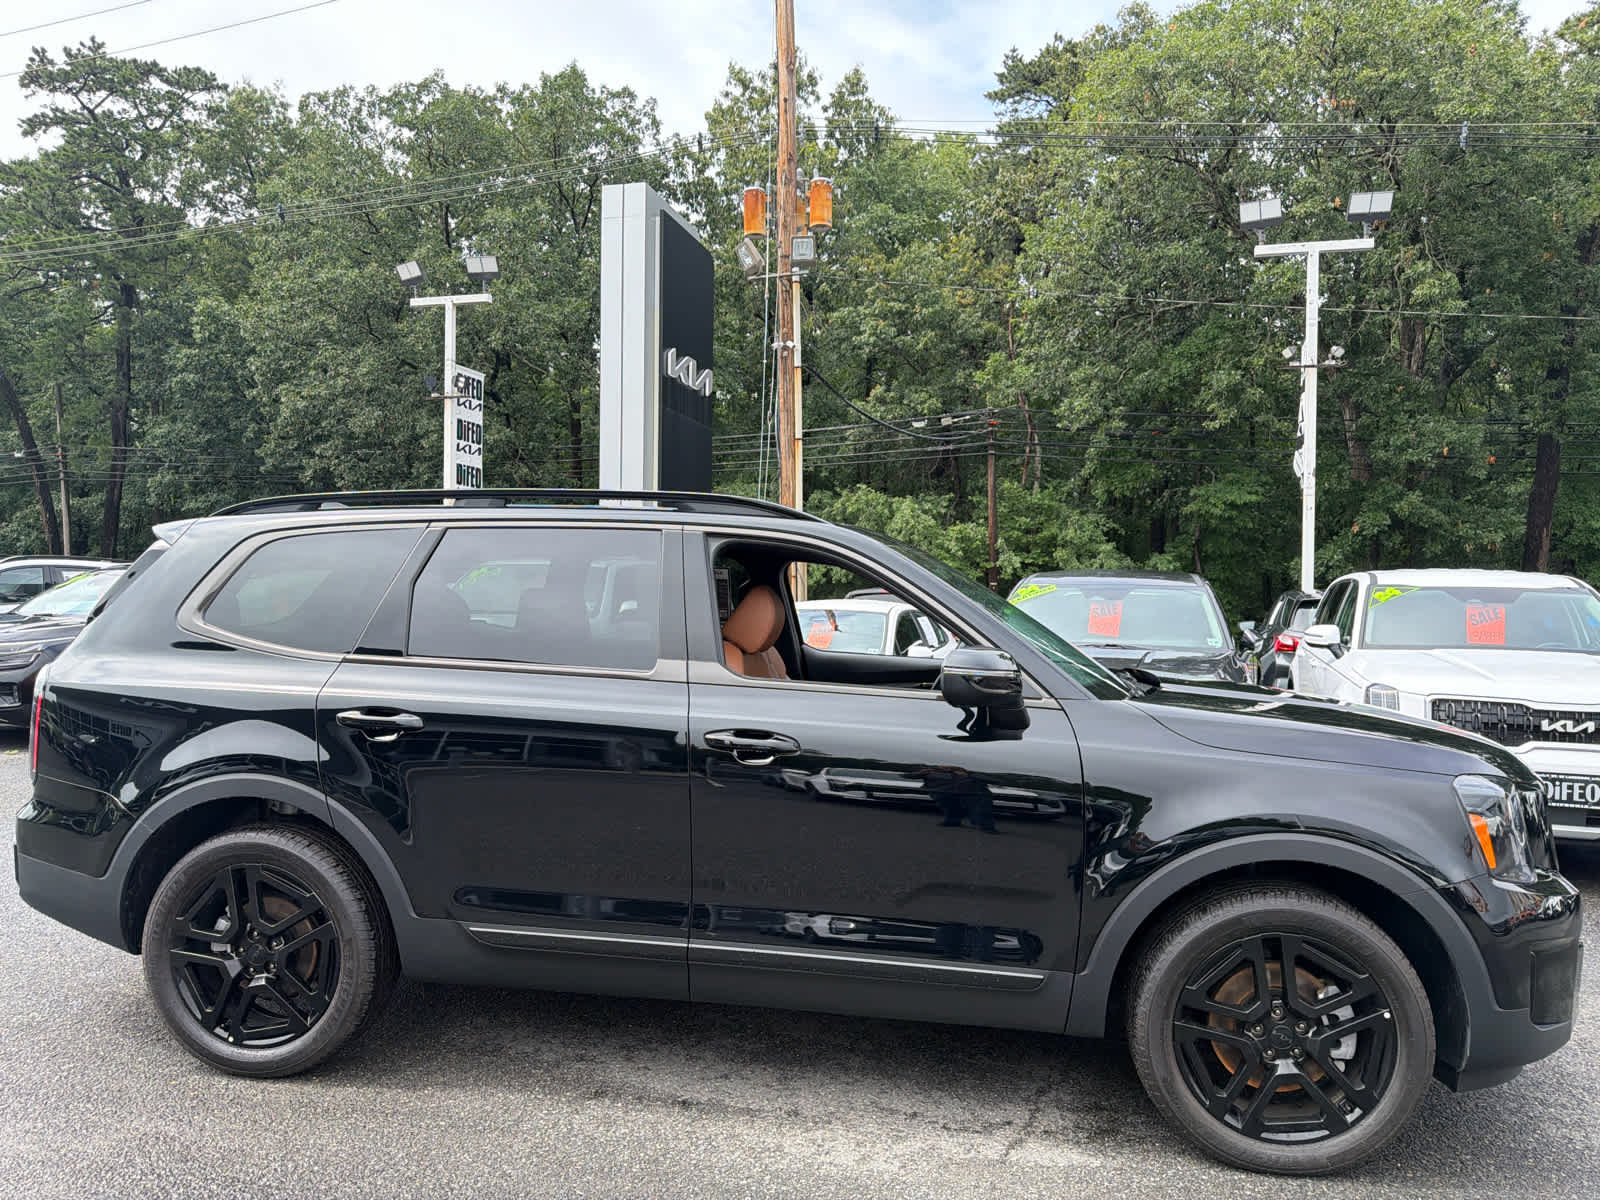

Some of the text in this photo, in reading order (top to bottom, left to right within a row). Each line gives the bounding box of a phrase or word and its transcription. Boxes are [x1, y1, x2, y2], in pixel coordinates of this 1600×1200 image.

[664, 347, 713, 397] KIA
[1469, 607, 1502, 626] SALE
[1541, 719, 1595, 733] KIA
